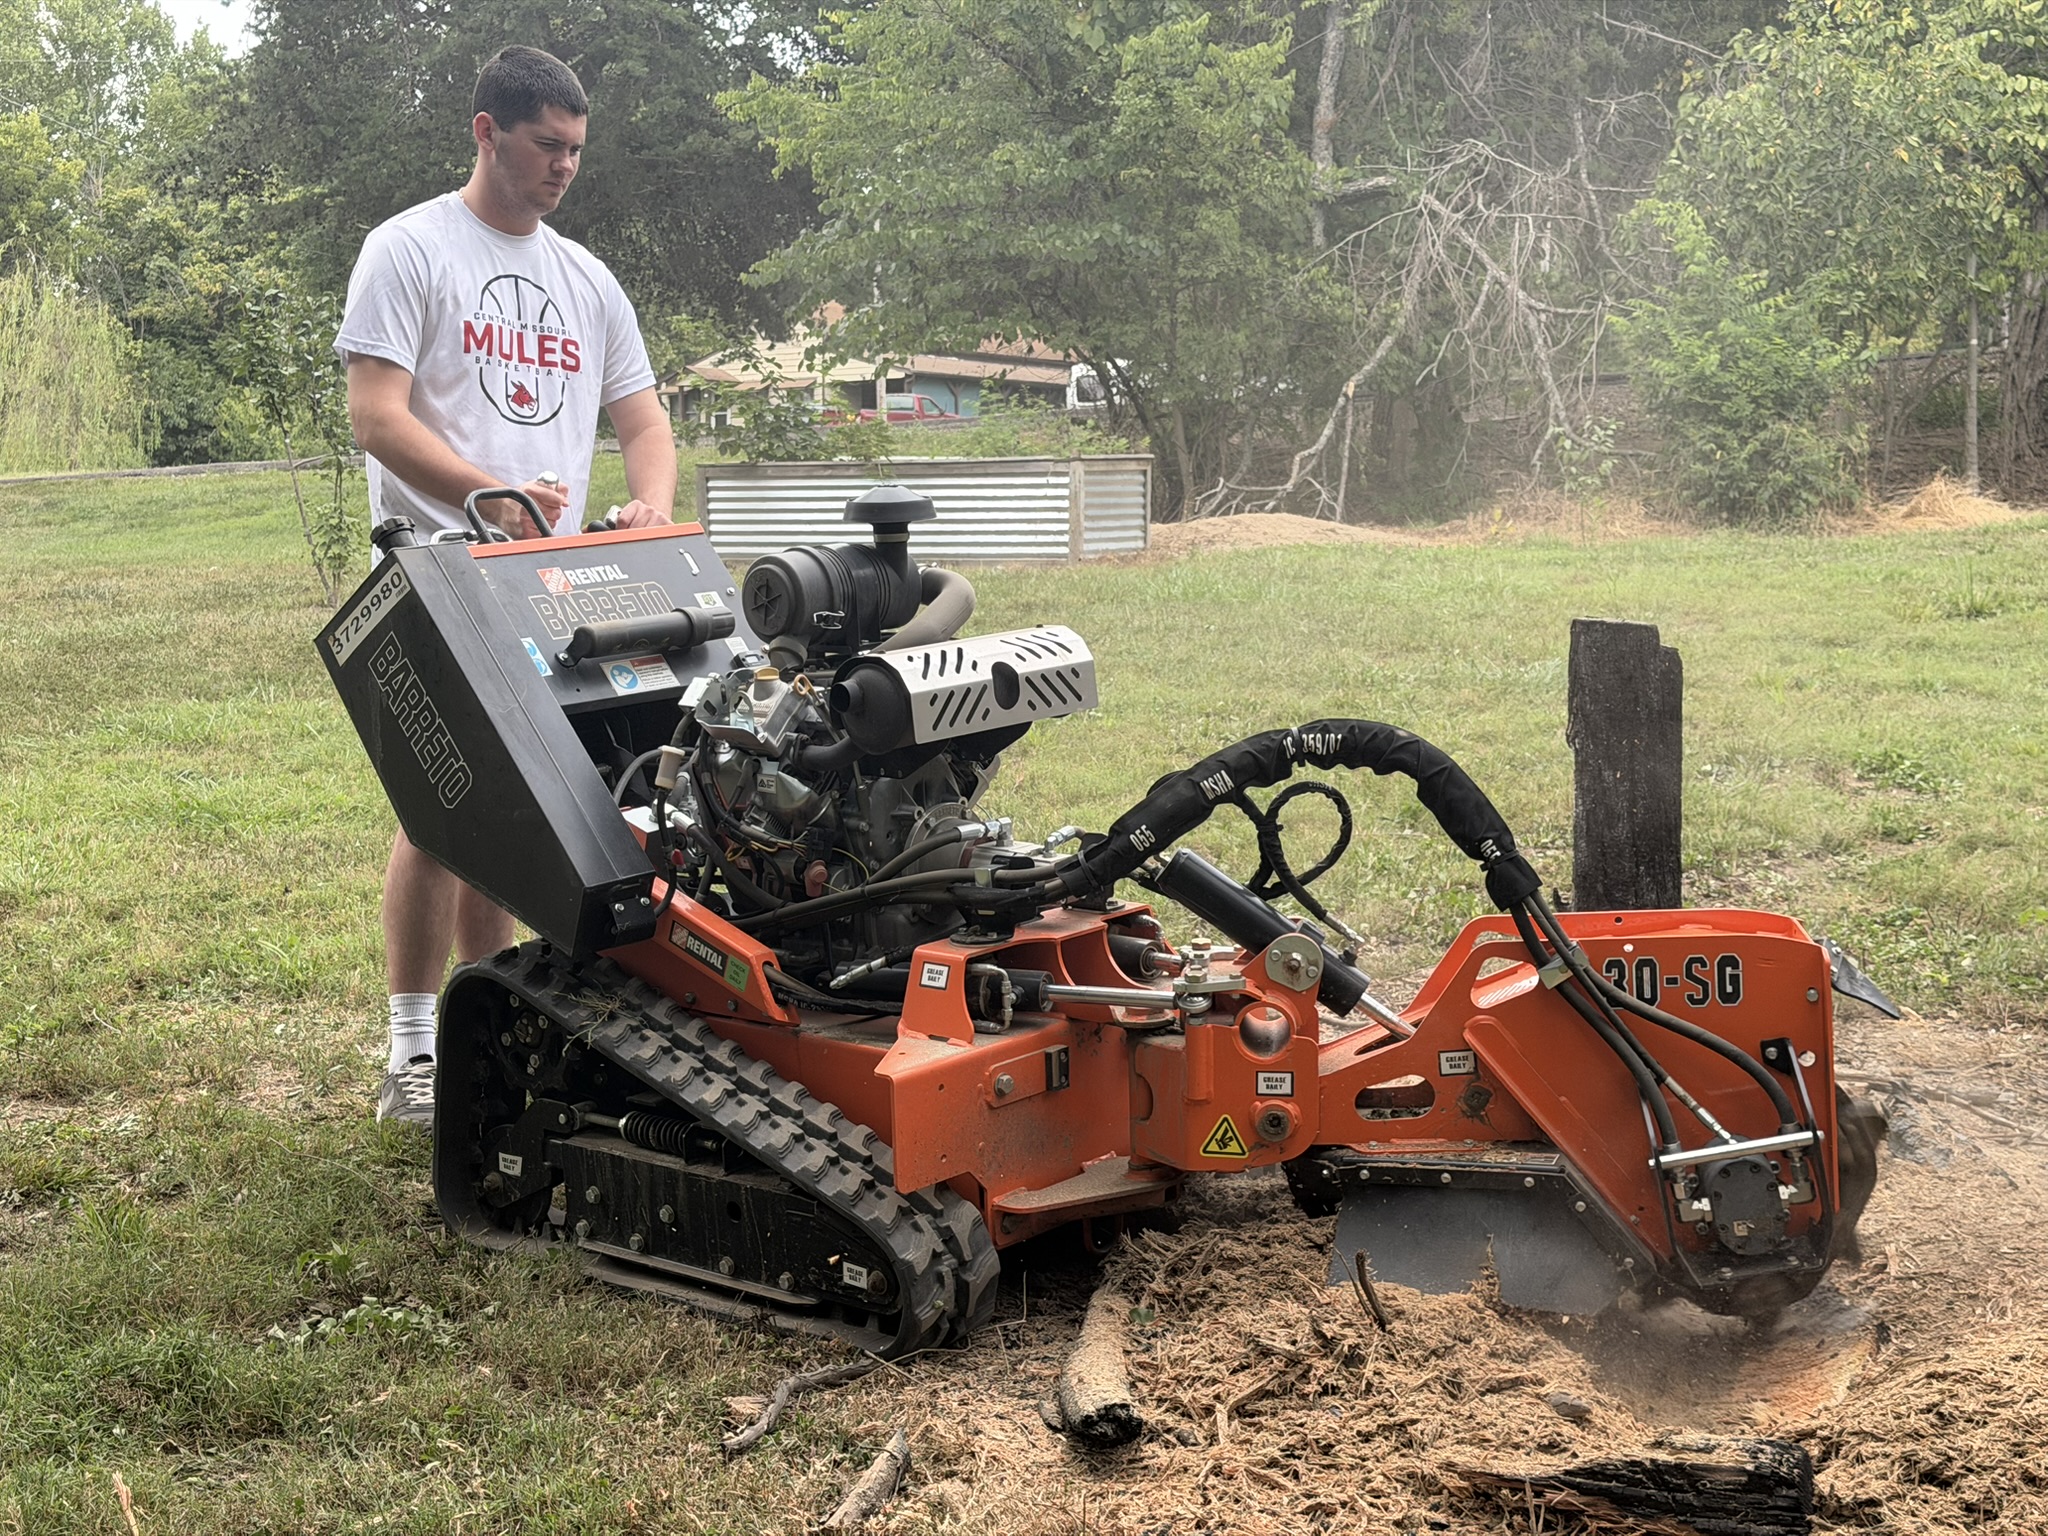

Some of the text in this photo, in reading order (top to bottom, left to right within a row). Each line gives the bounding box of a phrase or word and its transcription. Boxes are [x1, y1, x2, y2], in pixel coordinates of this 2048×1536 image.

[463, 320, 581, 373] MULES
[473, 312, 573, 338] CENTRAL MSSOURI
[475, 355, 571, 381] BASKETBALL
[564, 563, 629, 586] RENTAL
[332, 571, 403, 656] 3729980
[528, 582, 675, 640] BARRETO
[368, 630, 472, 809] BARRETO
[1129, 824, 1156, 852] 055
[1199, 769, 1235, 801] MSHA
[686, 935, 723, 970] RENTAL
[1262, 1076, 1287, 1084] GREASE
